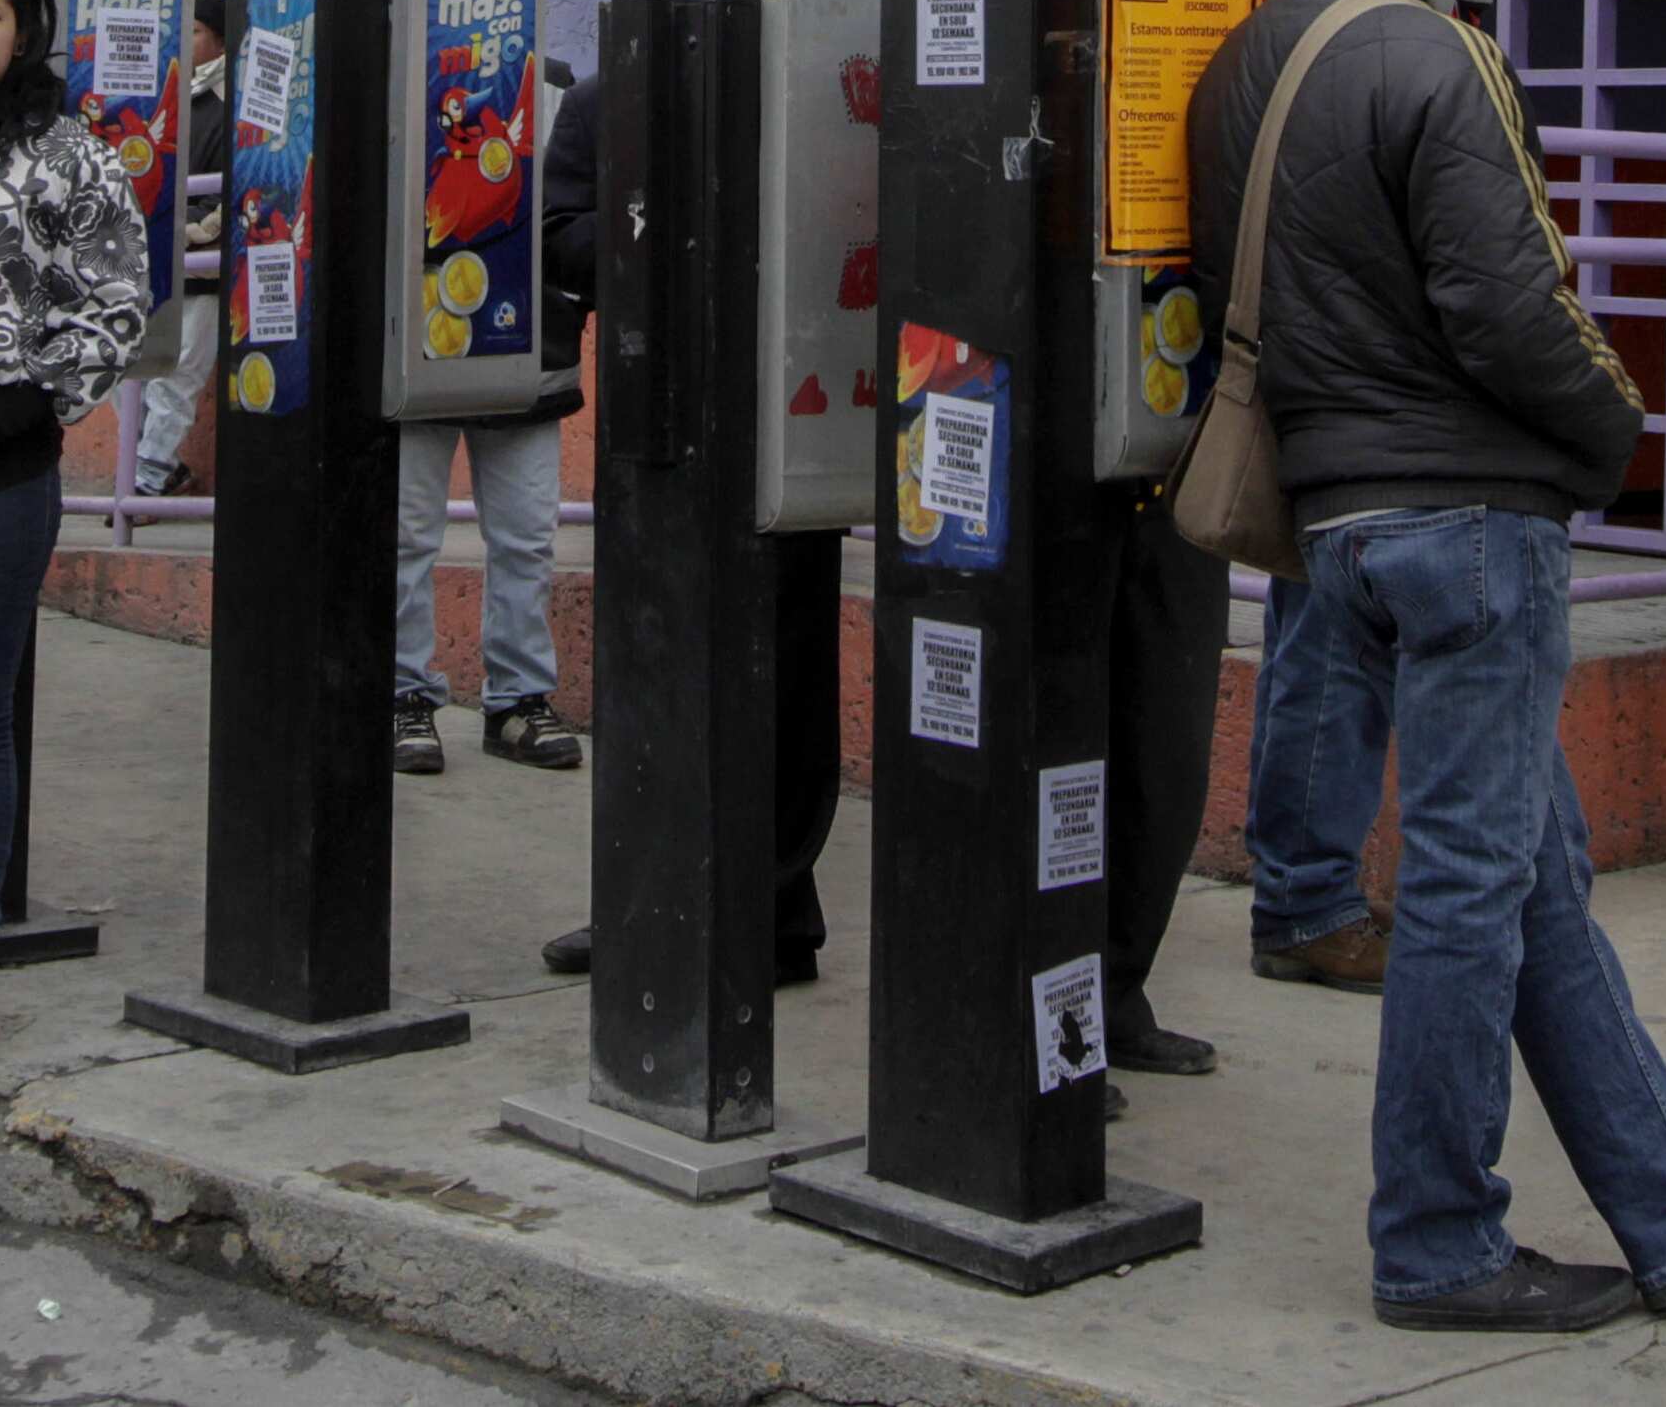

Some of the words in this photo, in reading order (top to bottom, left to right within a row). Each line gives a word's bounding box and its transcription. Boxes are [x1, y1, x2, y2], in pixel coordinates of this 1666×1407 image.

[932, 2, 975, 14] SECUNDARIA
[488, 15, 523, 35] con
[1131, 22, 1172, 36] Estamos
[1174, 26, 1231, 37] contratand
[438, 33, 525, 79] migo
[936, 417, 988, 437] PREPARATORIA
[938, 430, 983, 449] SECUNDARIA
